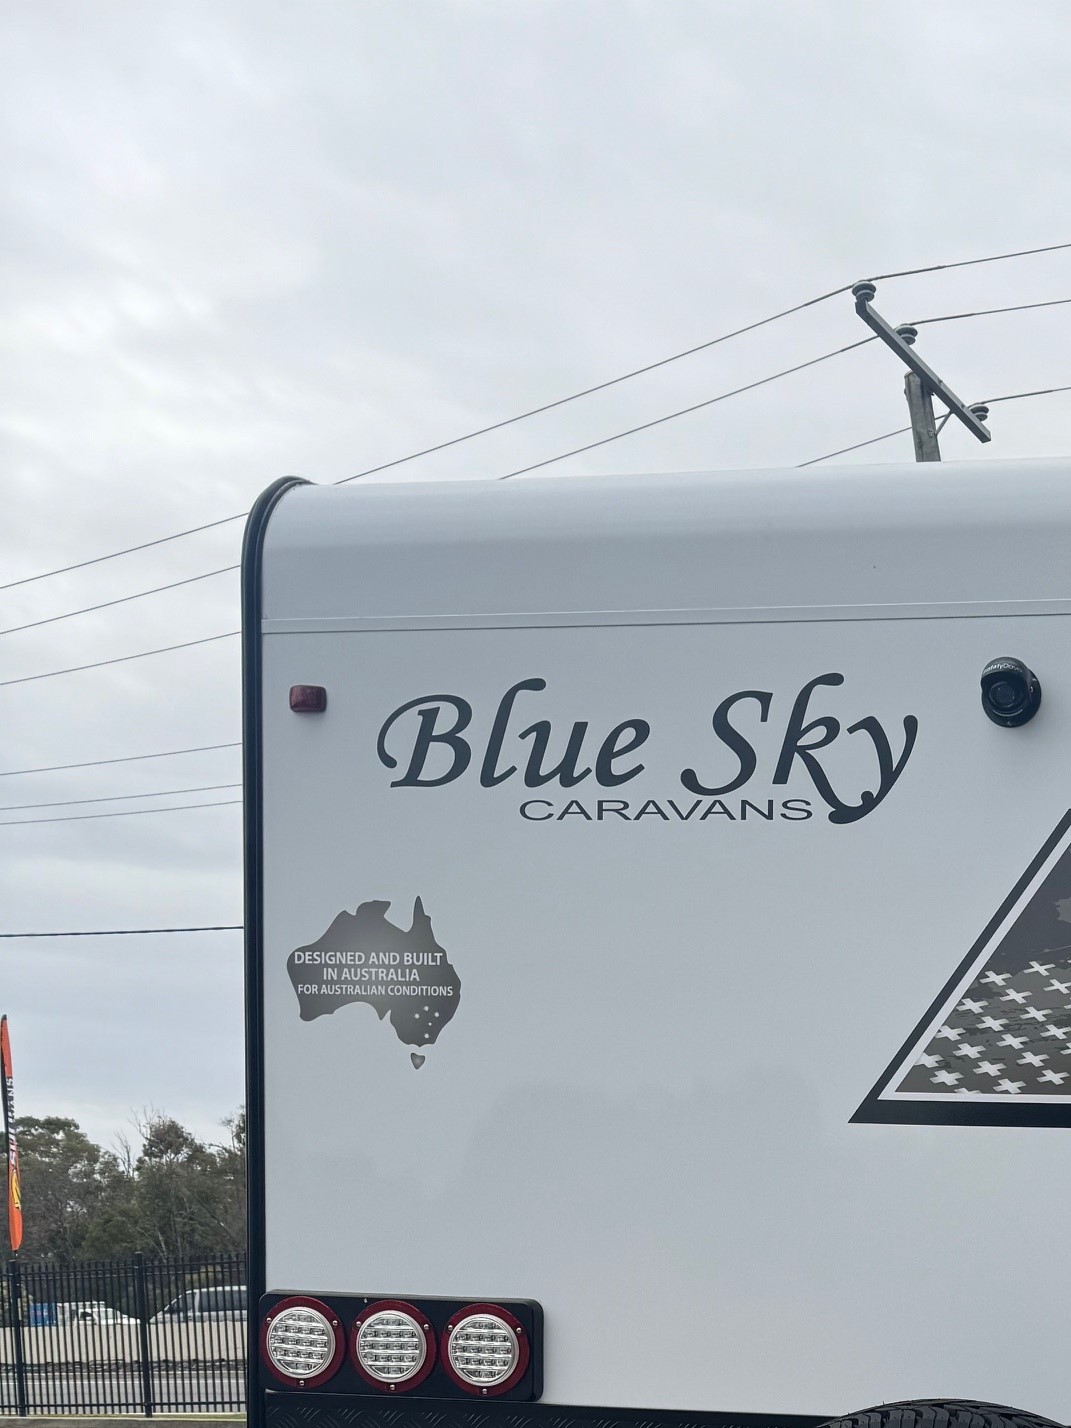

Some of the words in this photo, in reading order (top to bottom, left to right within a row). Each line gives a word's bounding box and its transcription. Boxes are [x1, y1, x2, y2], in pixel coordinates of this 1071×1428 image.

[376, 677, 651, 789] Blue
[680, 672, 919, 825] Sky
[518, 797, 813, 821] CARAVANS
[294, 951, 366, 965] DESIGNED
[368, 952, 400, 965] AND
[403, 952, 444, 966] BUILT
[323, 967, 338, 981] IN
[340, 967, 420, 982] AUSTRALIA
[297, 984, 319, 995] FOR
[320, 984, 386, 996] AUSTRALIAN
[387, 985, 454, 997] CONDITIONS
